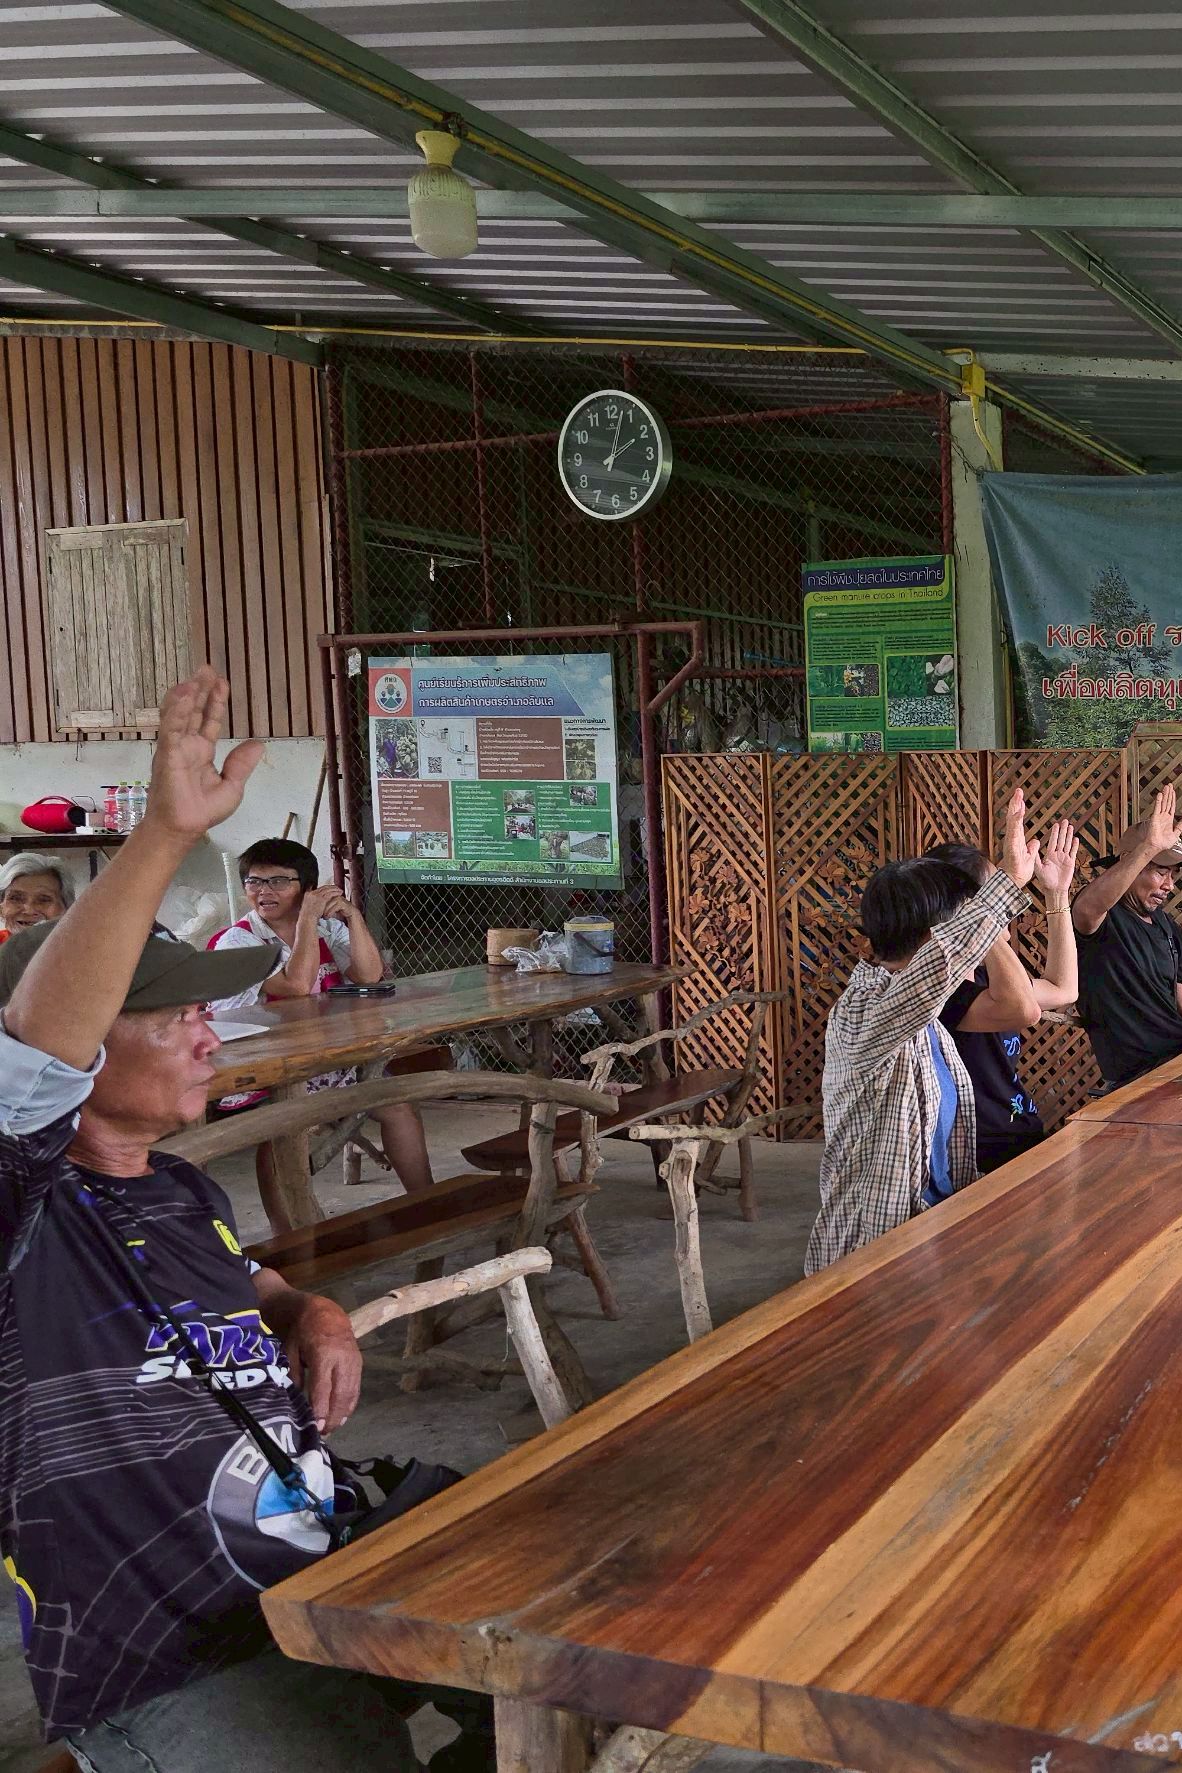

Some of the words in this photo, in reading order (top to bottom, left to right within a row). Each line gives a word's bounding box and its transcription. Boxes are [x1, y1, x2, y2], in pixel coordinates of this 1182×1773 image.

[604, 405, 618, 419] 12
[627, 409, 633, 423] 1
[588, 412, 600, 427] 11
[575, 430, 589, 444] 10
[640, 425, 648, 439] 2
[574, 453, 582, 467] 9
[645, 447, 654, 461] 3
[580, 475, 588, 488] 8
[642, 470, 650, 483] 4
[593, 490, 602, 503] 7
[630, 487, 638, 500] 5
[612, 494, 620, 508] 6
[812, 593, 838, 602] Green
[841, 591, 871, 601] manure
[873, 591, 896, 600] crops
[908, 588, 944, 598] Thailand
[1046, 624, 1107, 648] Kick
[1115, 622, 1156, 648] off
